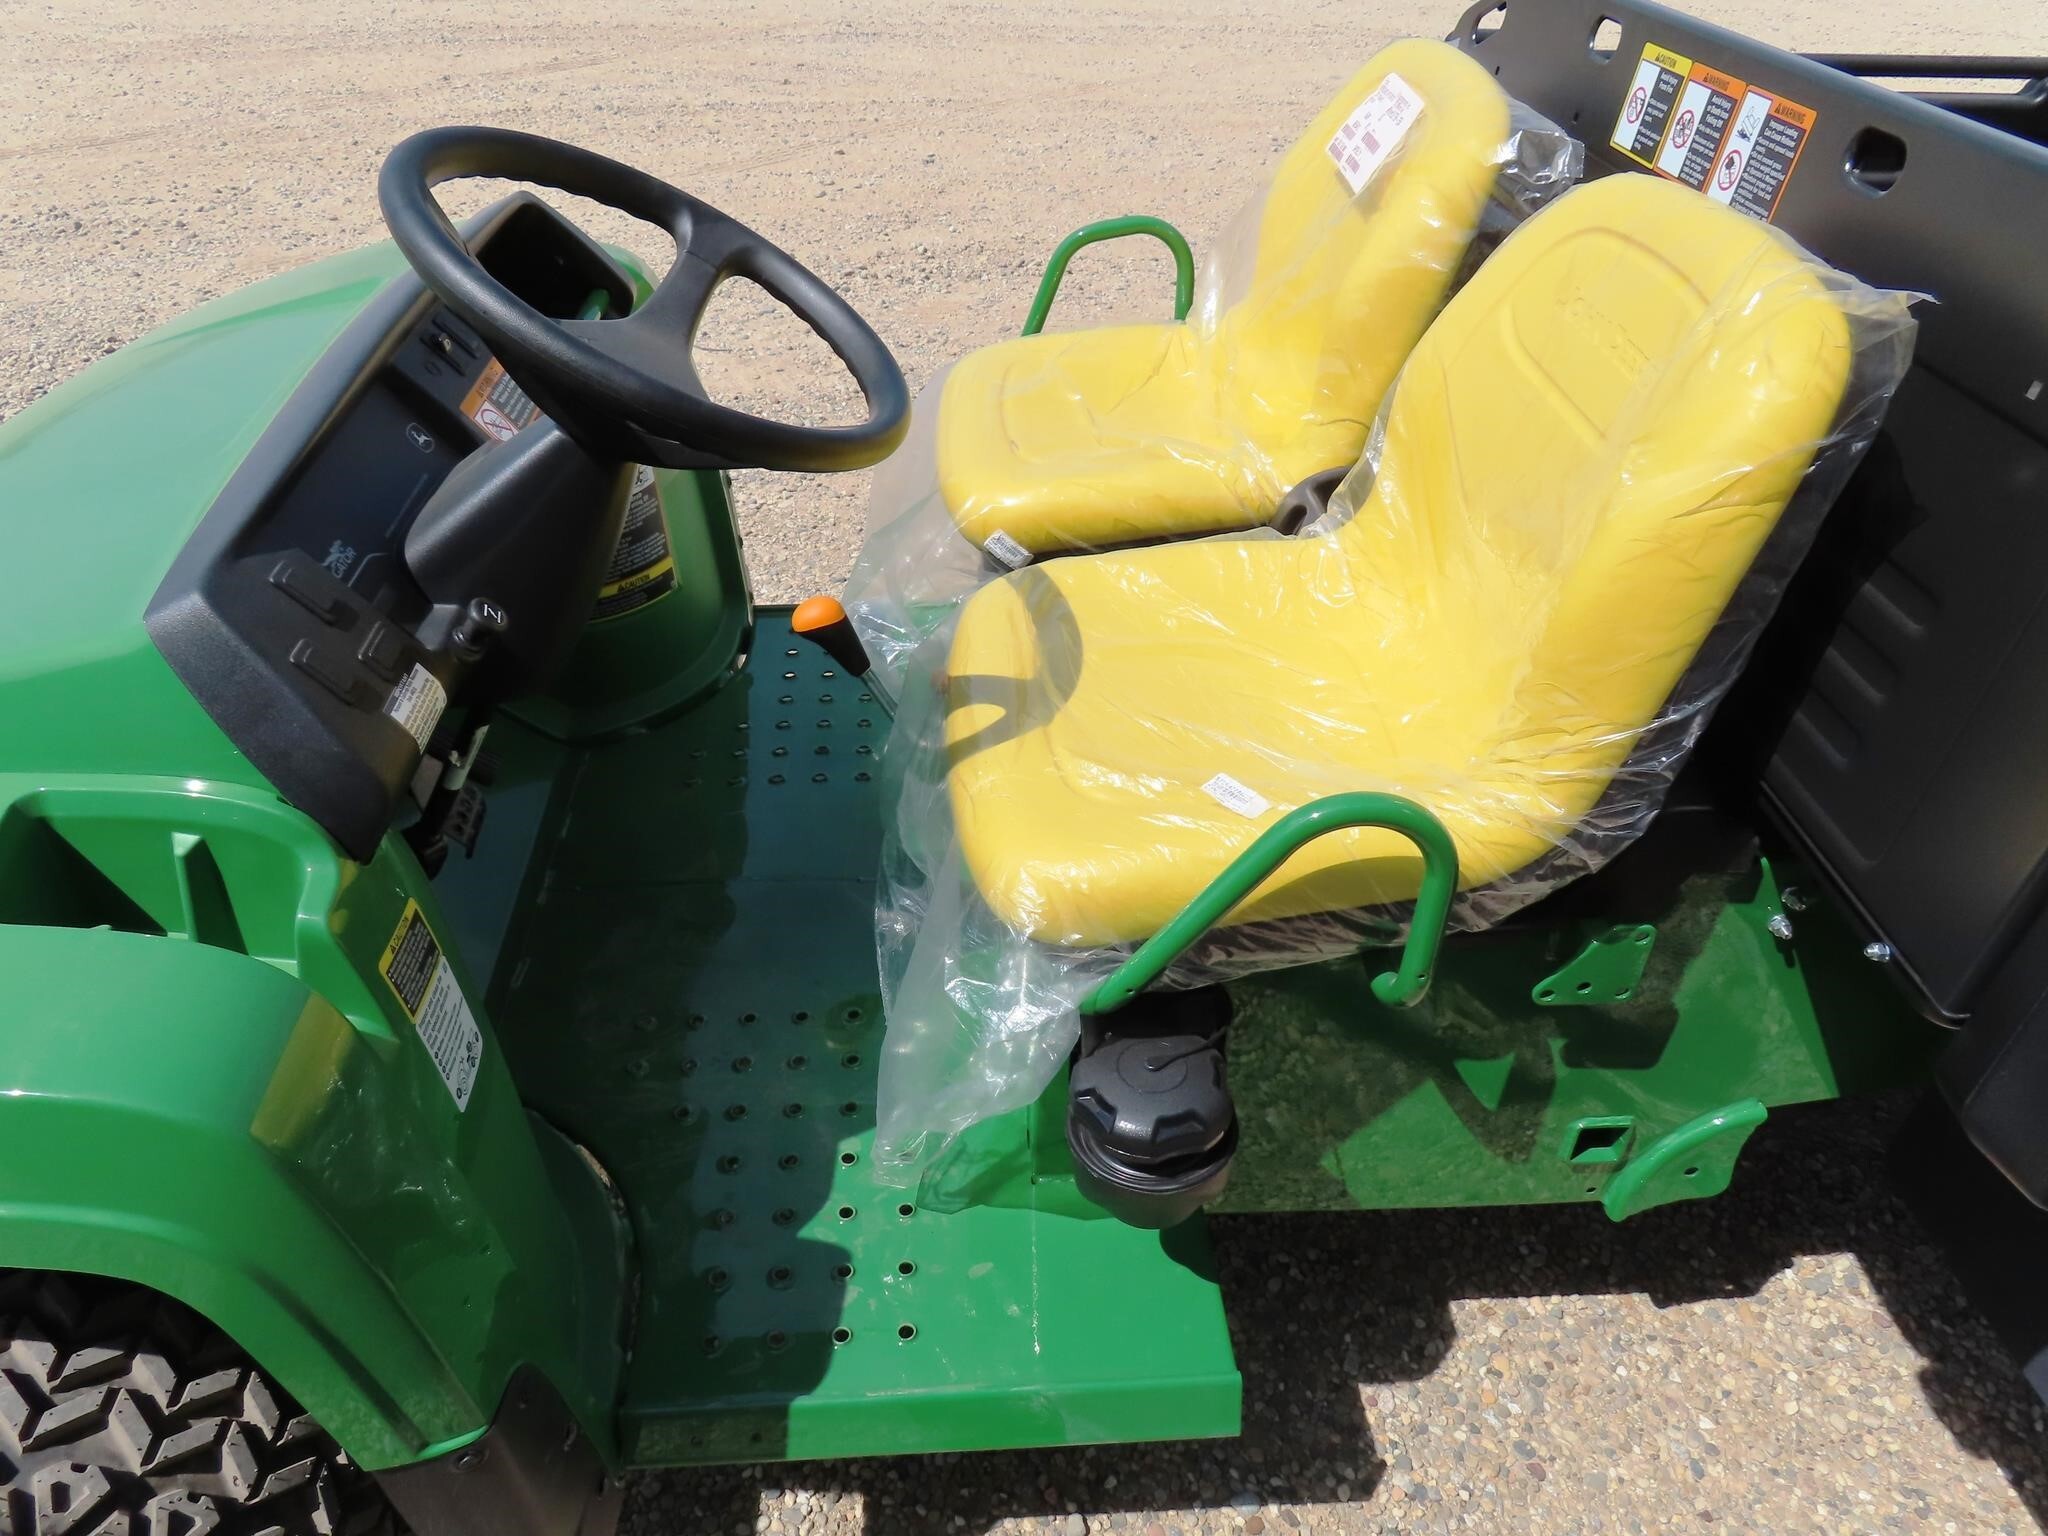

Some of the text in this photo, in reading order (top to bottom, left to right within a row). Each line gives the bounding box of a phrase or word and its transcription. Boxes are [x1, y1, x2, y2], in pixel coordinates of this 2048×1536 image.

[1658, 53, 1677, 68] CAUTION
[1707, 74, 1730, 91] WARNING
[1778, 104, 1806, 124] WARNING
[332, 546, 357, 578] GATOR
[625, 574, 650, 589] CAUTION
[392, 916, 410, 943] CAUTION
